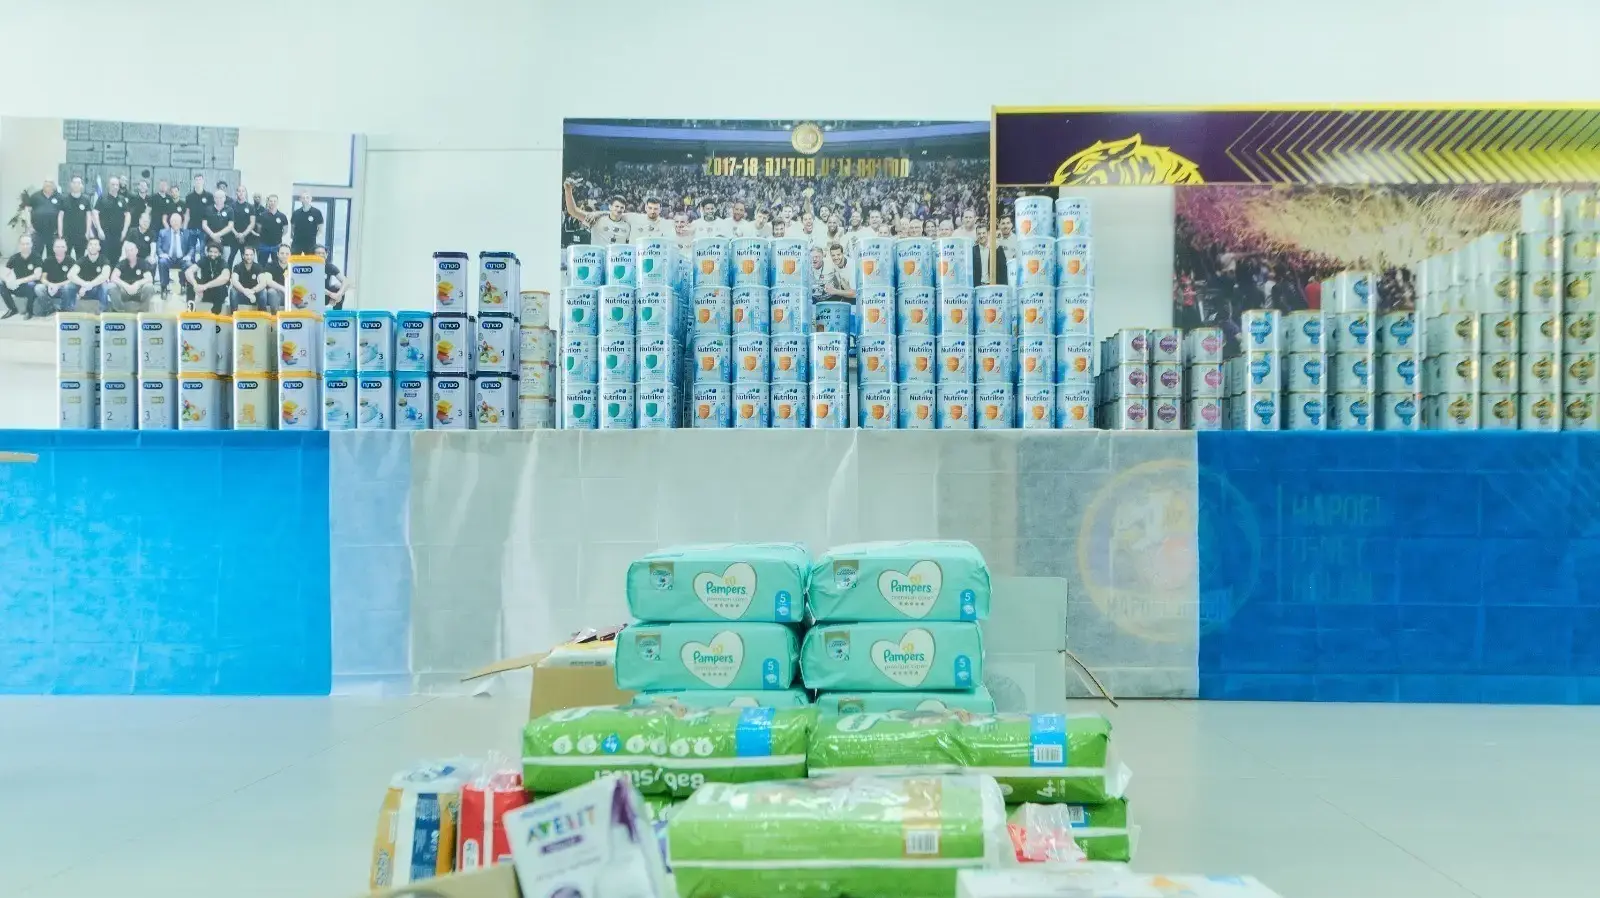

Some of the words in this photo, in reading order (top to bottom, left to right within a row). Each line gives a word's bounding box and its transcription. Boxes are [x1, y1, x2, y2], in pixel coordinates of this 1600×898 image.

[706, 157, 758, 176] 2017-18
[765, 157, 815, 176] המדינה
[706, 581, 746, 595] Pampers
[891, 580, 931, 593] Pampers
[780, 594, 786, 603] 5
[965, 592, 971, 602] 5
[692, 651, 733, 665] Pampers
[884, 649, 924, 664] Pampers
[959, 659, 966, 668] 5
[768, 661, 774, 670] 5
[1036, 779, 1056, 798] 4+
